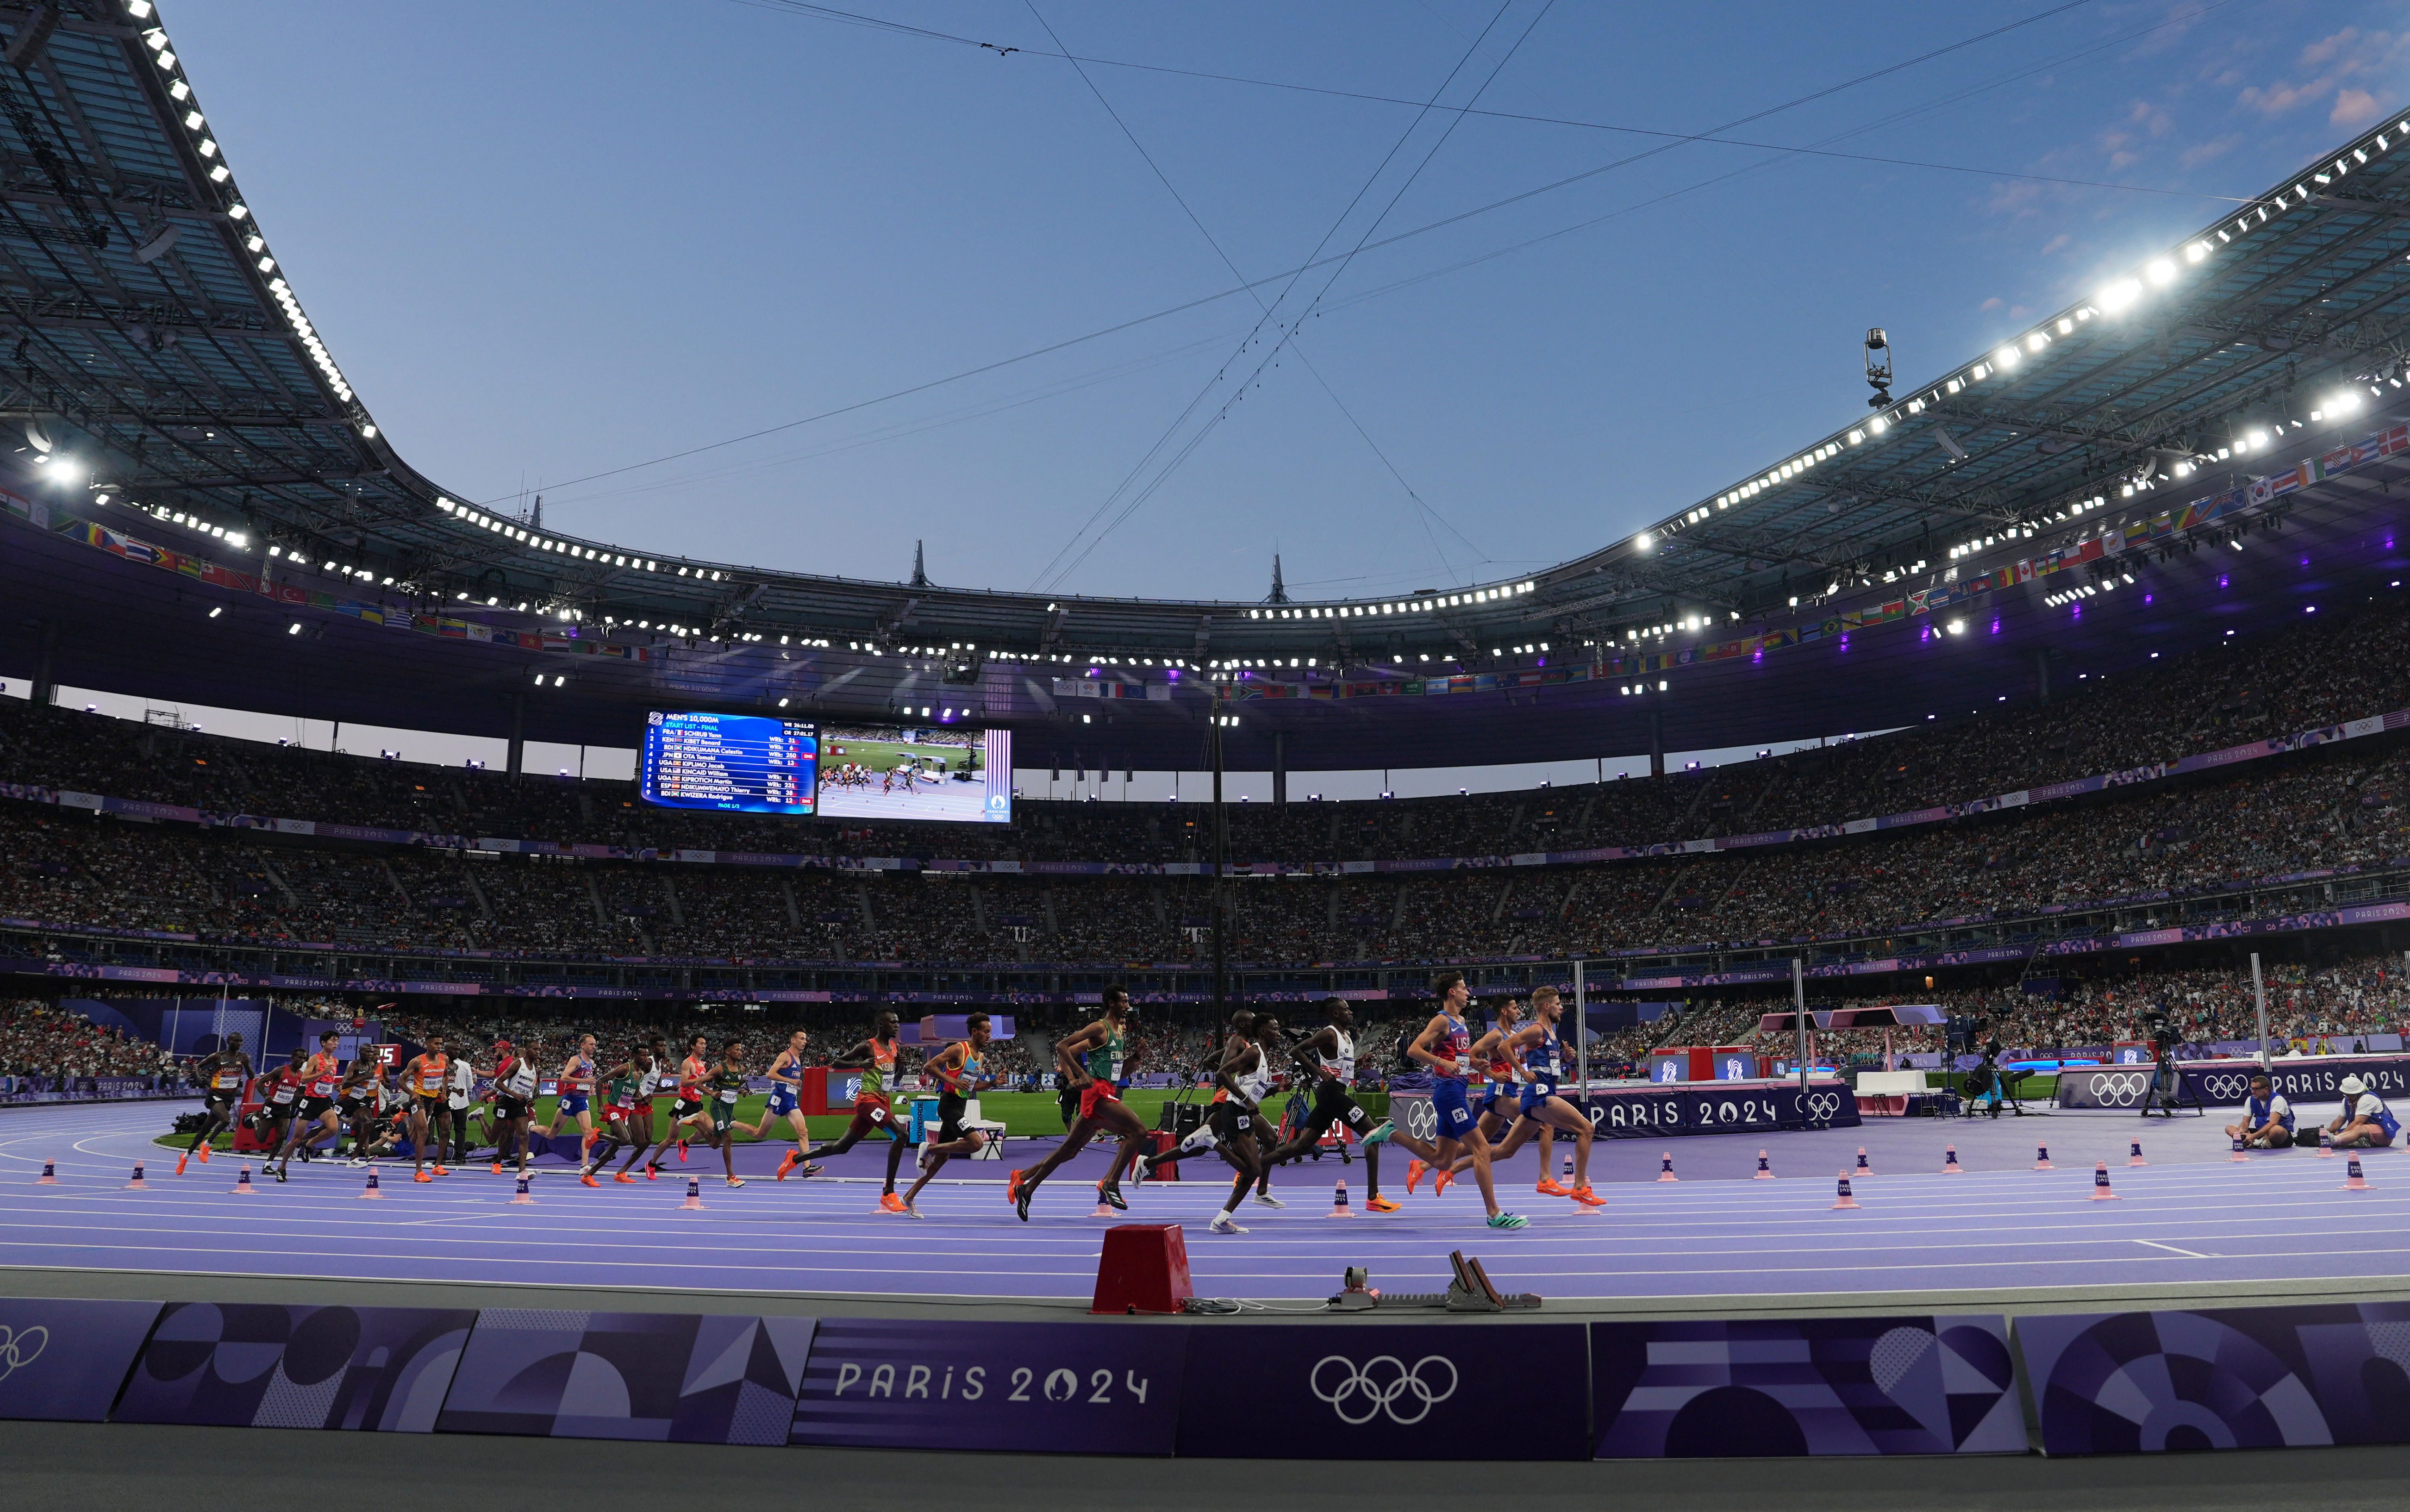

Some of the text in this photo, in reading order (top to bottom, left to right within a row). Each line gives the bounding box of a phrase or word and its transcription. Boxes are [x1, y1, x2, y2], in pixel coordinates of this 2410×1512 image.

[2207, 747, 2257, 763] PARIS 2024
[2042, 783, 2084, 796] PARIS 2024
[123, 803, 180, 816] PARIS 2024
[333, 828, 360, 837] PARIS
[2383, 907, 2406, 916] 2024
[122, 1081, 145, 1090] 2024
[2271, 1071, 2335, 1094] PARIS
[1351, 1109, 1361, 1119] 23
[1590, 1100, 1776, 1128] PARIS 2024
[959, 1119, 969, 1129] 20
[1240, 1118, 1249, 1126] 26
[834, 1362, 1149, 1405] PARIS 2024
